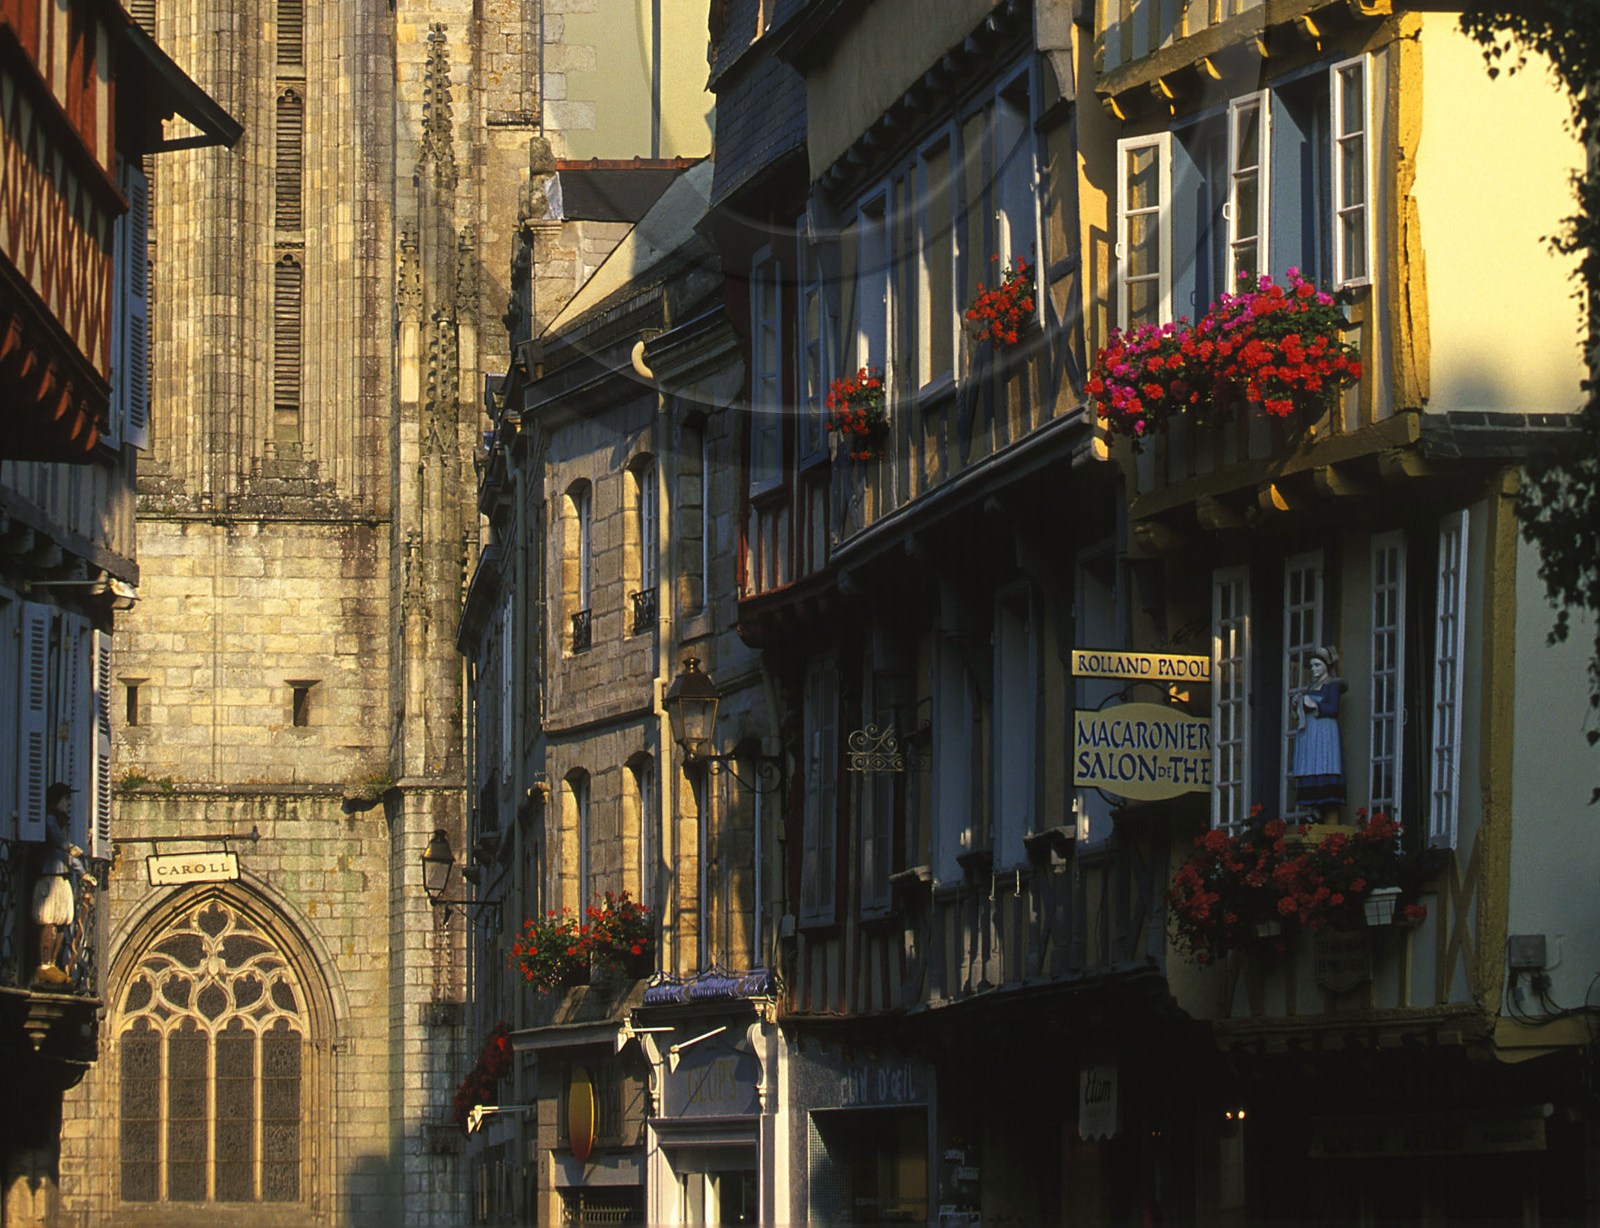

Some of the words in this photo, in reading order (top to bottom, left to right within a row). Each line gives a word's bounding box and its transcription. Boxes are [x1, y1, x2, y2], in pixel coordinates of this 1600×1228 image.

[1078, 654, 1152, 675] ROLLAND
[1077, 720, 1211, 751] MACARONIER
[1077, 751, 1158, 782] SALON
[1158, 766, 1172, 778] DE
[1168, 757, 1211, 785] THE
[156, 863, 230, 876] CAROLL
